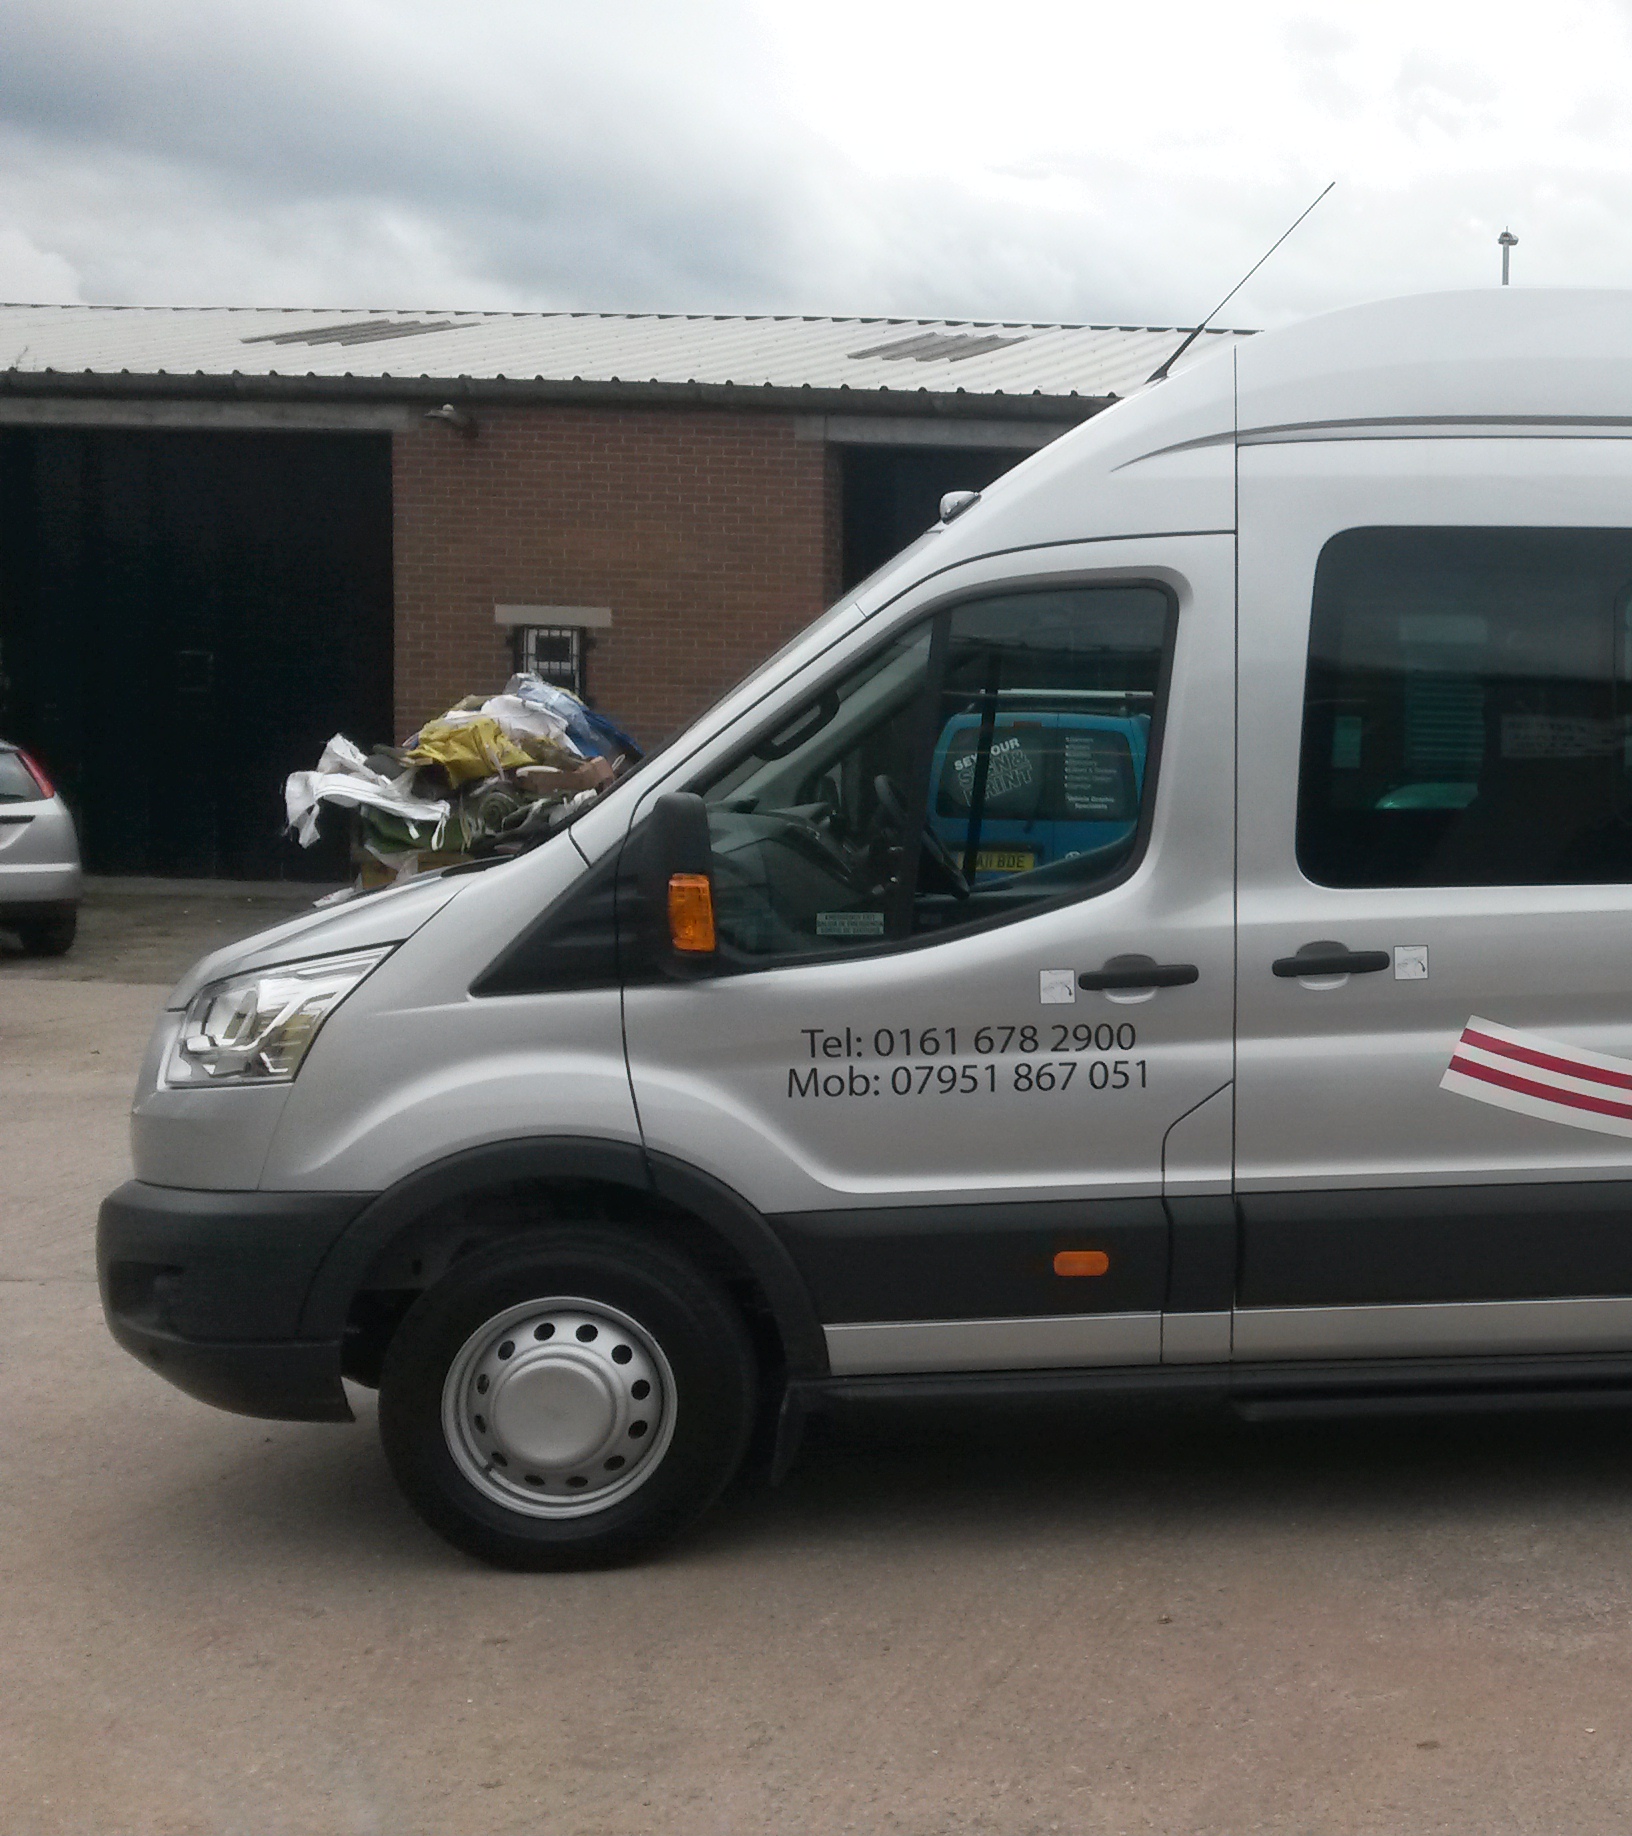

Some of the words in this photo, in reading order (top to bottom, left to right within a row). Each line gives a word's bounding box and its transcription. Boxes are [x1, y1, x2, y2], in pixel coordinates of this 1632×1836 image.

[954, 737, 1020, 771] SEYOUR
[801, 1027, 863, 1059] Tel:
[873, 1027, 958, 1057] 0161
[973, 1024, 1039, 1055] 678
[1050, 1022, 1137, 1053] 2900
[787, 1065, 881, 1099] Mob:
[890, 1063, 997, 1096] 07951
[1012, 1060, 1078, 1093] 867
[1088, 1059, 1148, 1091] 051
